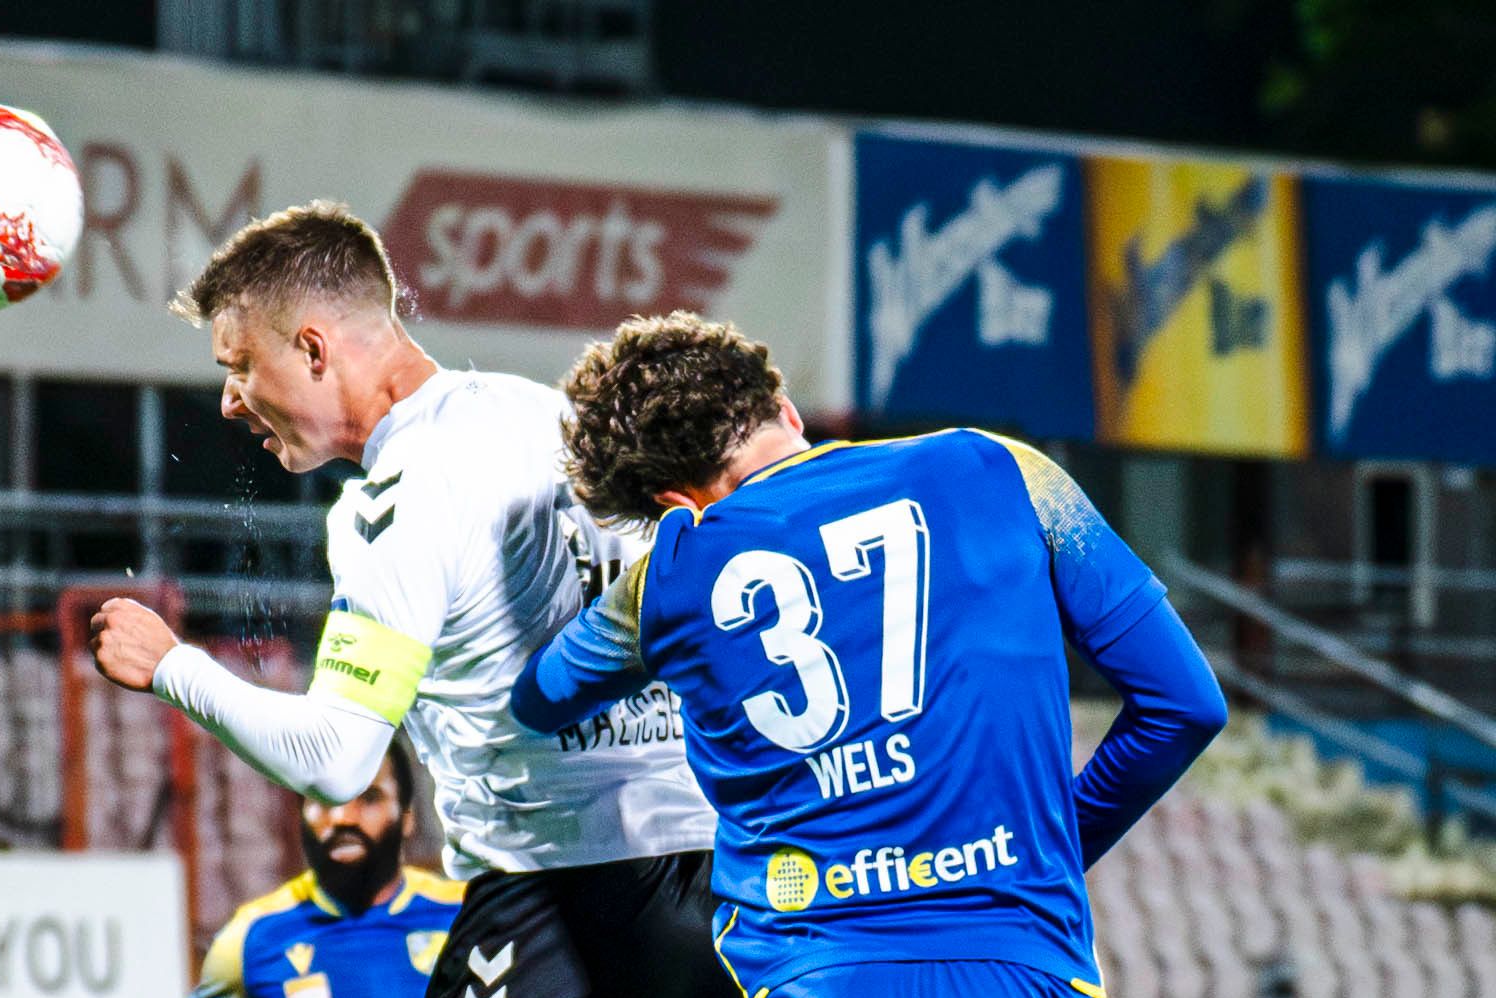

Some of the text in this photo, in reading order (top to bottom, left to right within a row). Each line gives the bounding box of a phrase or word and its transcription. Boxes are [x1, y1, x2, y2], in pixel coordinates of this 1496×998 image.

[419, 202, 666, 307] sports
[711, 497, 930, 754] 37
[805, 733, 916, 800] WELS
